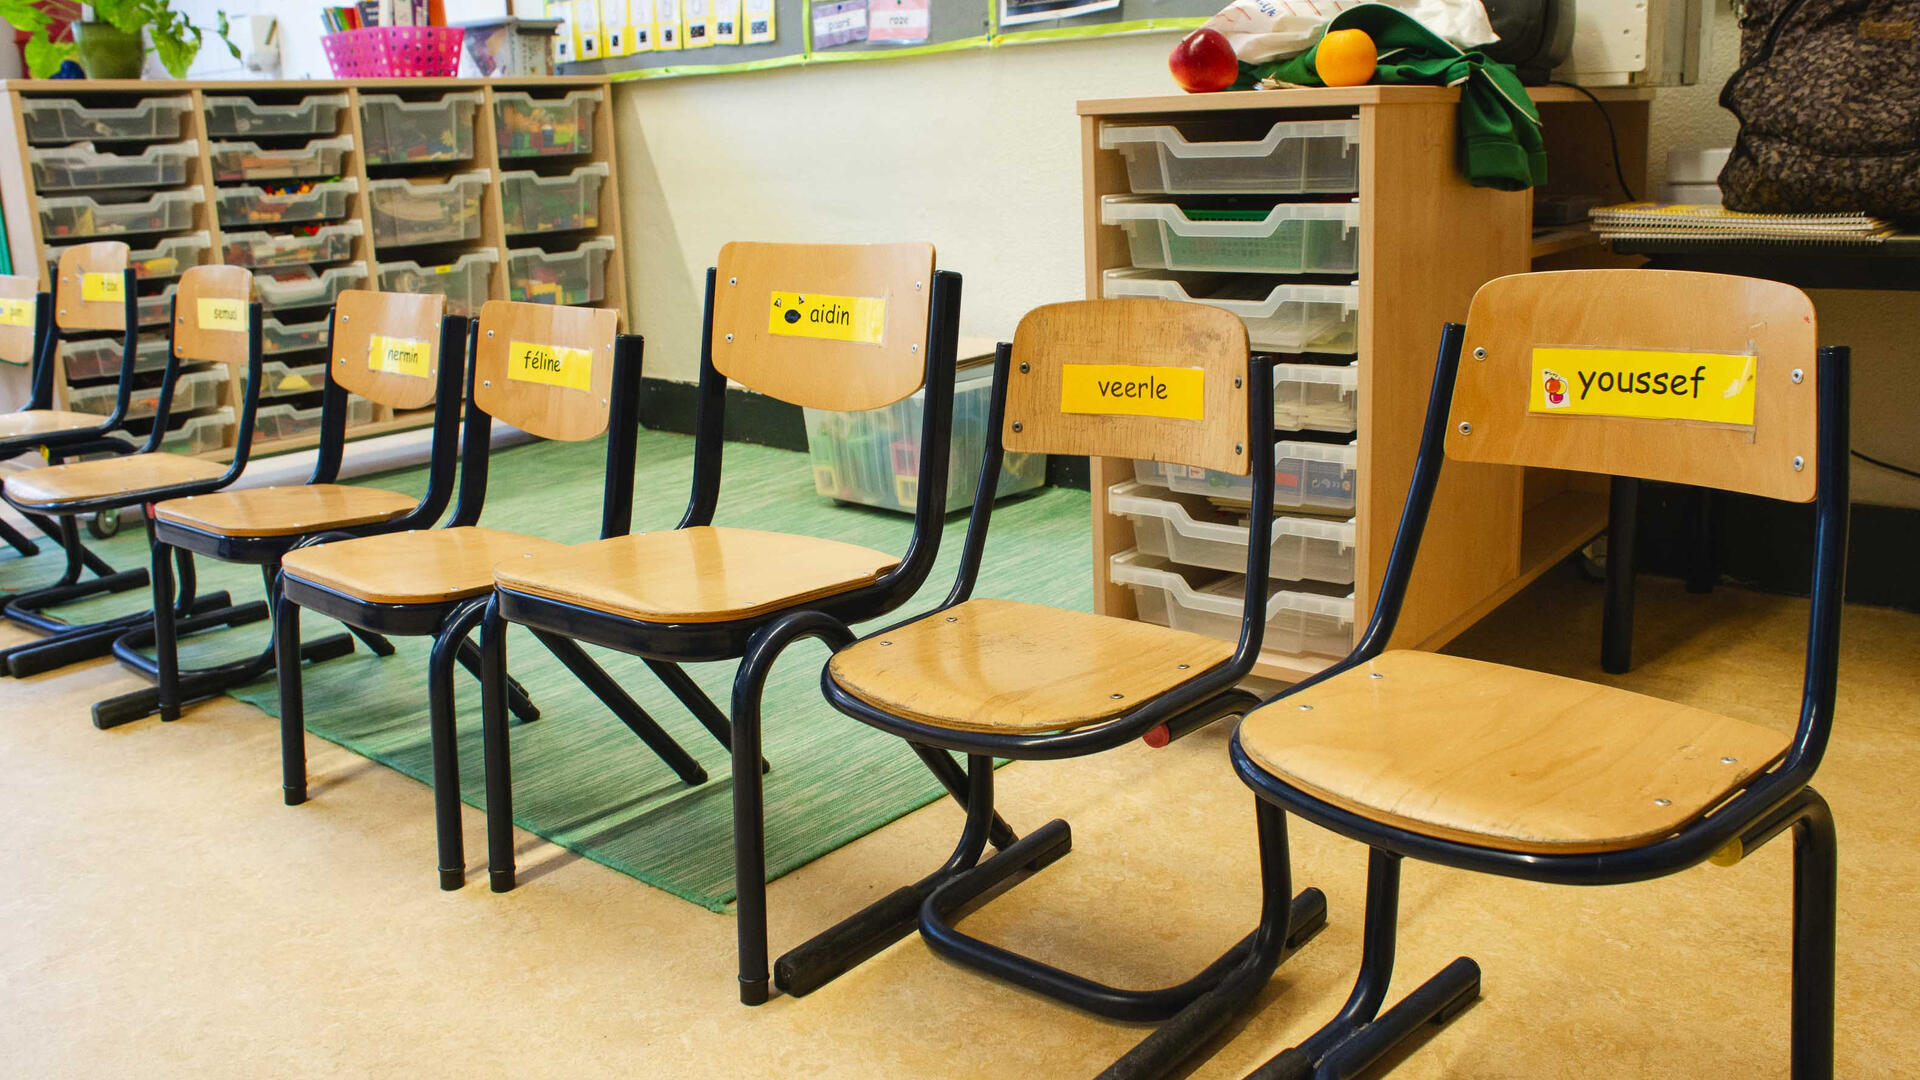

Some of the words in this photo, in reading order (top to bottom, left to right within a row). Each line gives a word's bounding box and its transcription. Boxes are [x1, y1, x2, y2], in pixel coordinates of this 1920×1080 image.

[810, 303, 850, 326] aidin
[387, 347, 418, 364] nermin
[524, 350, 561, 372] féline
[1098, 375, 1168, 400] veerle
[1578, 365, 1706, 401] youssef
